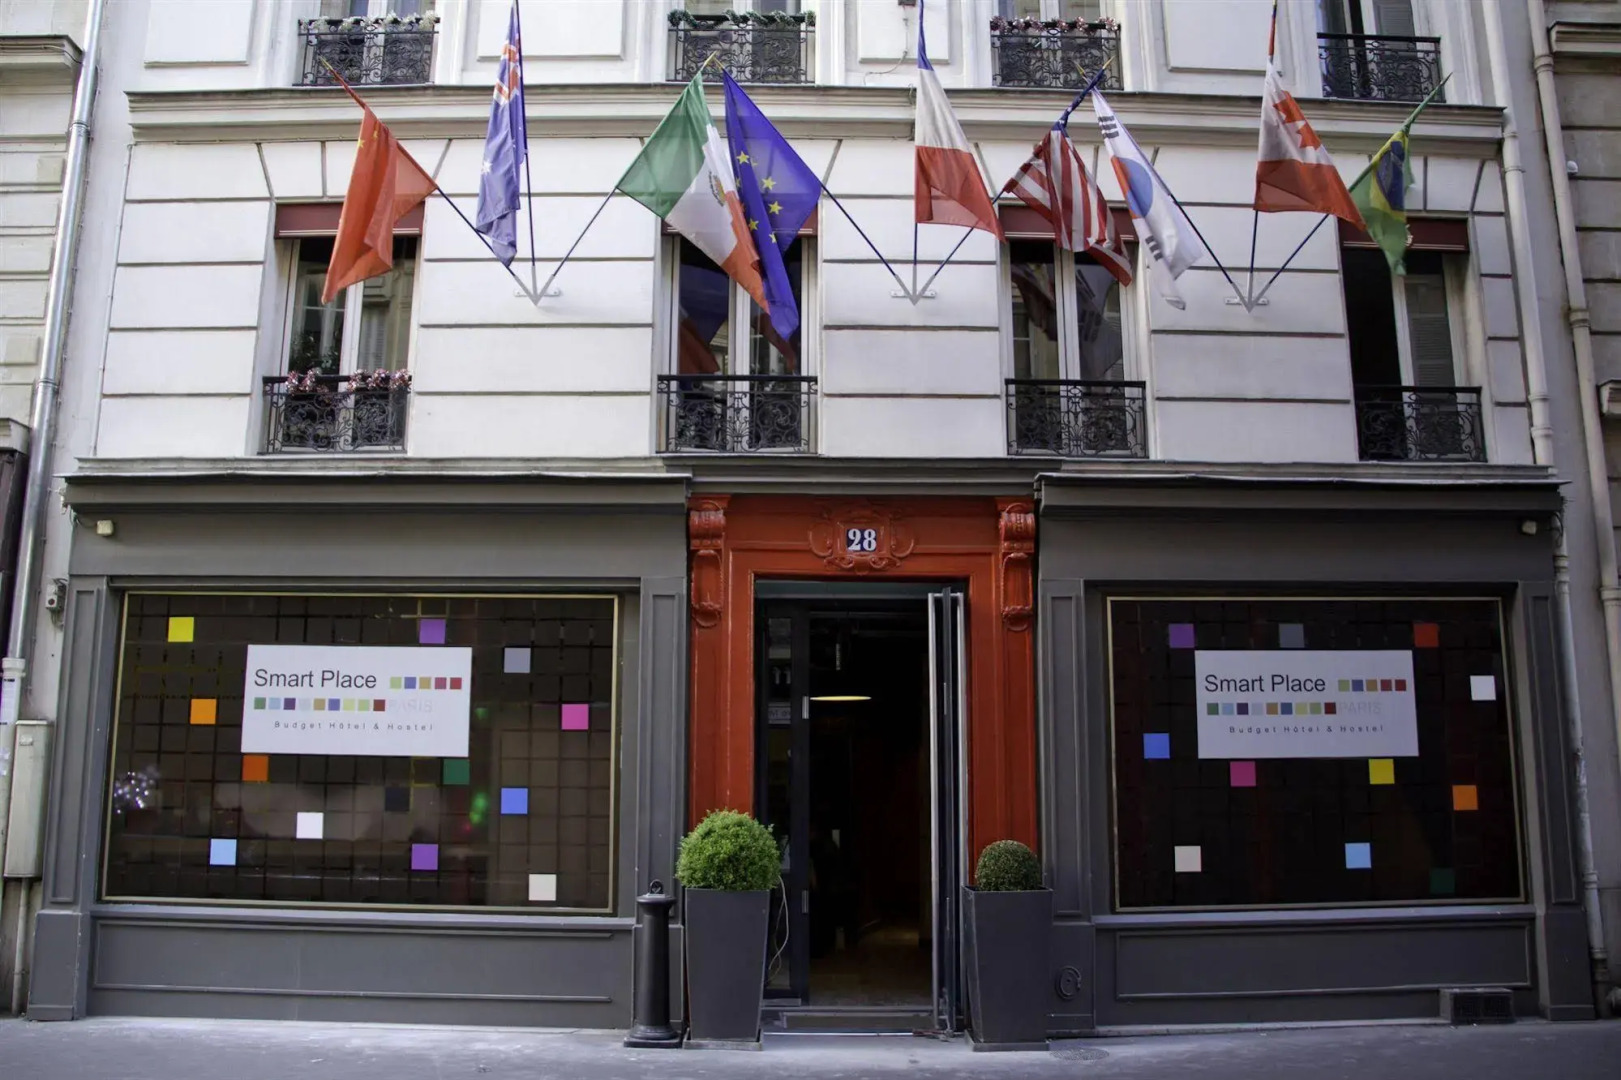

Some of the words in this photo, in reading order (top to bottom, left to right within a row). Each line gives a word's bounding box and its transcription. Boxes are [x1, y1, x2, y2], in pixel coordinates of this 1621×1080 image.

[848, 528, 877, 551] 28
[254, 669, 314, 688] Smart
[321, 670, 377, 688] Place
[1205, 674, 1264, 692] Smart
[1271, 674, 1326, 692] Place
[1338, 702, 1382, 715] PARIS
[274, 721, 322, 730] Budget
[373, 721, 380, 730] &
[387, 722, 433, 731] Hostel
[1229, 726, 1276, 734] Budget
[1340, 725, 1384, 733] Hostel
